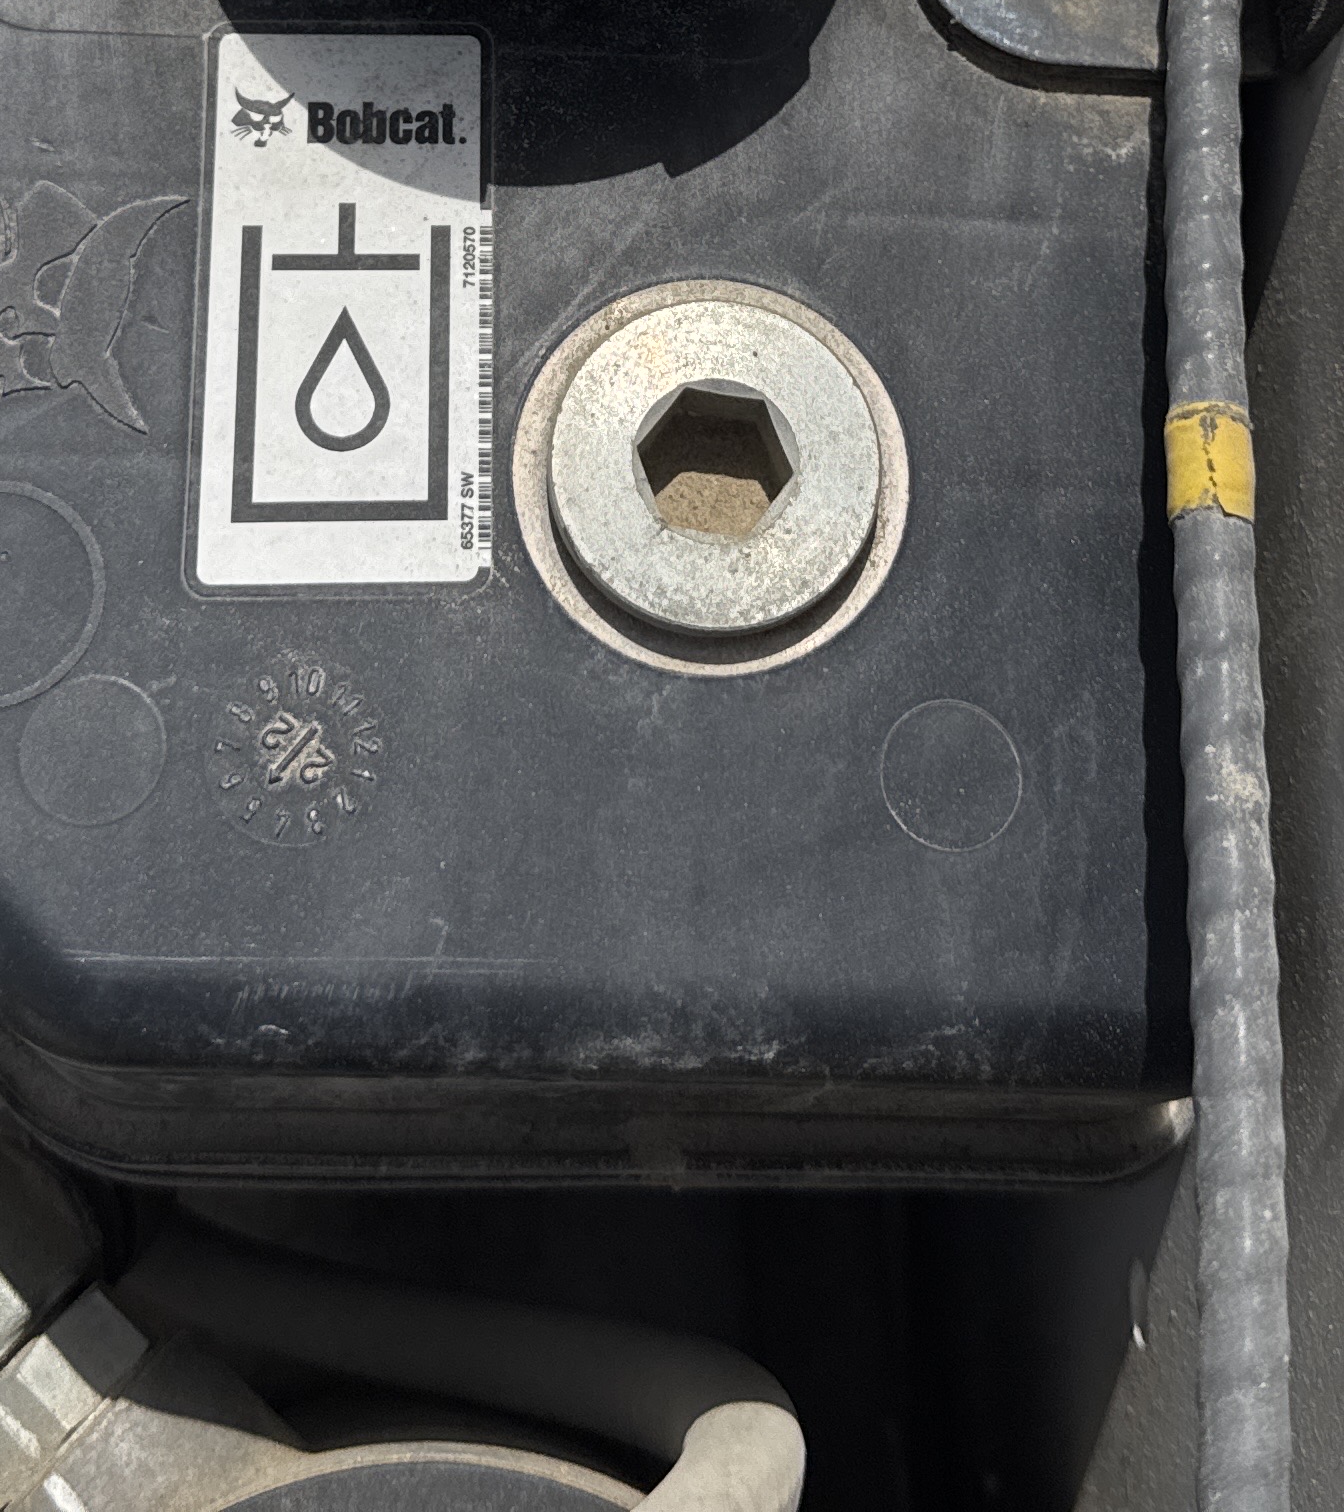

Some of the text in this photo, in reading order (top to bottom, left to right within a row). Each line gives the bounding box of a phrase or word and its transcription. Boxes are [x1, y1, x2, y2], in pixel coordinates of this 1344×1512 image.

[462, 225, 476, 288] 7120570
[460, 471, 474, 550] 65377 SW
[288, 666, 326, 696] 10
